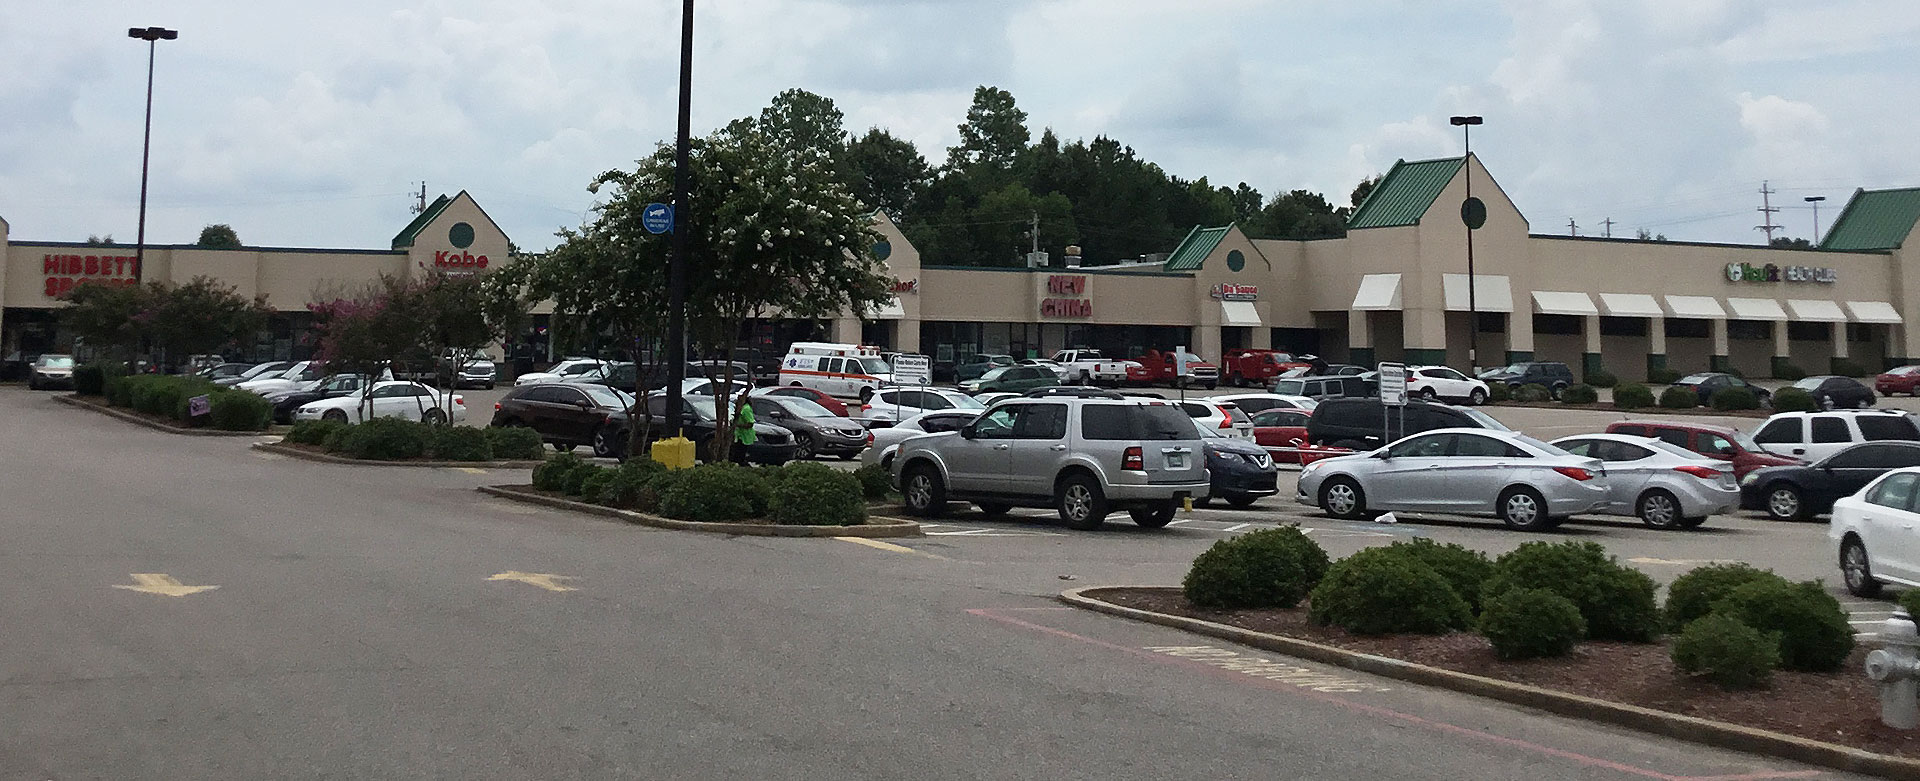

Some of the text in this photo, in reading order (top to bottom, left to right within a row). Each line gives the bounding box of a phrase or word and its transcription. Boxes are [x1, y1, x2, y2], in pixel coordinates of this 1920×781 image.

[43, 254, 138, 276] HIBBETT
[435, 250, 489, 269] Kobe
[1048, 275, 1086, 294] NEW
[1041, 298, 1092, 317] CHINA
